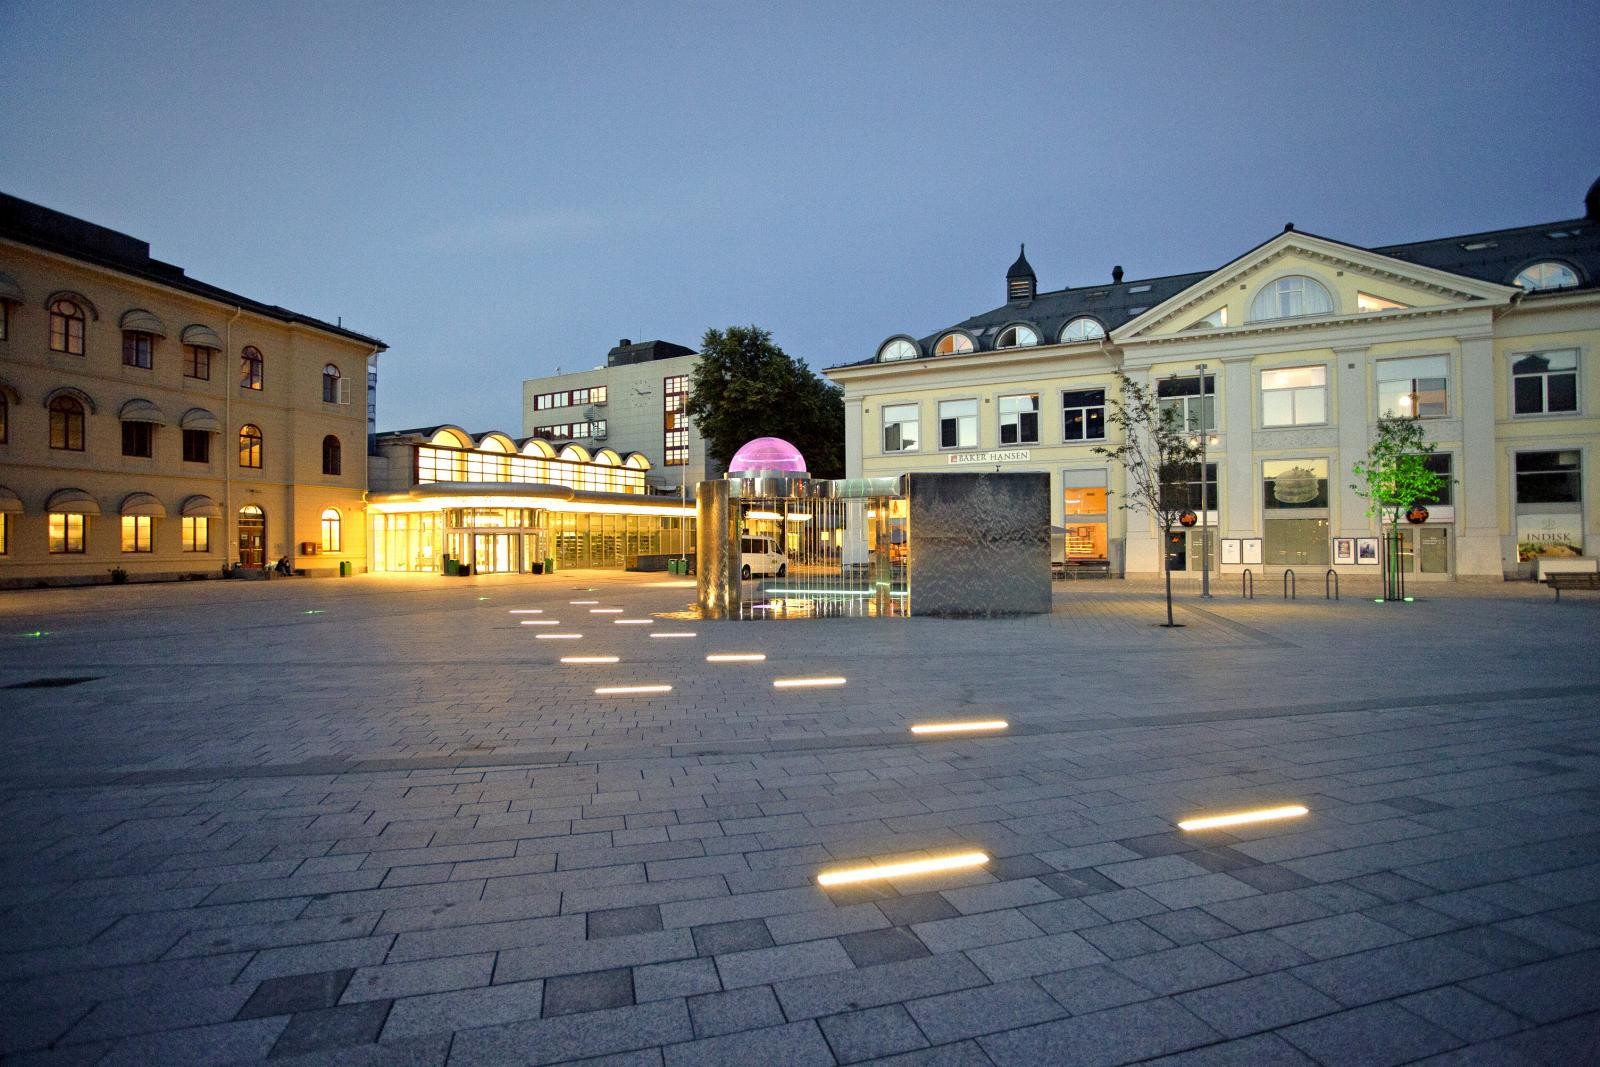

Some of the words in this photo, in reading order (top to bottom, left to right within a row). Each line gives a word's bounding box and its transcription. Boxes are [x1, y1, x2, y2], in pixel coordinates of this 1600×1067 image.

[959, 453, 988, 462] BAKER
[990, 451, 1028, 461] HANSEN
[1527, 532, 1571, 541] INDISK
